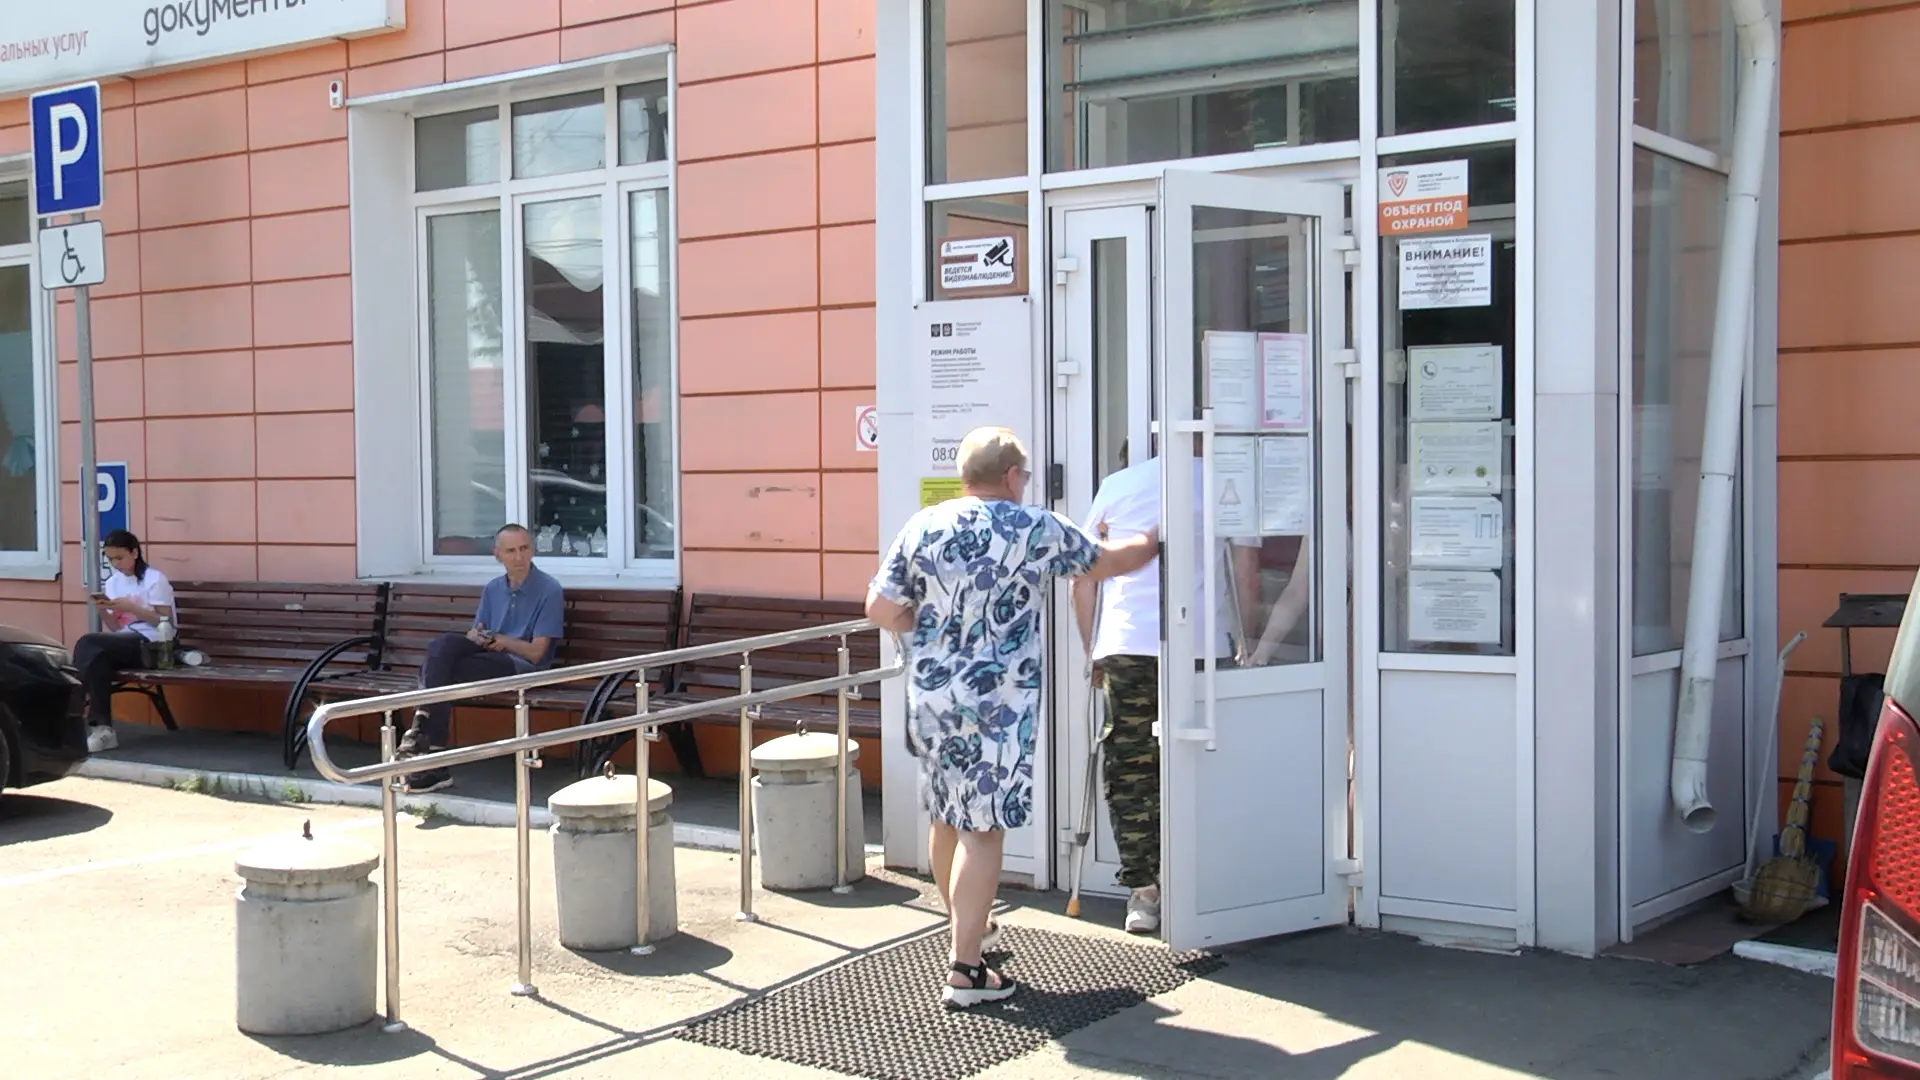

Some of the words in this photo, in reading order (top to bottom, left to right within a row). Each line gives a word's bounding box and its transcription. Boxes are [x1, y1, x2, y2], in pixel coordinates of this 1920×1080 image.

[53, 30, 89, 60] услуг
[50, 102, 88, 201] P
[1382, 202, 1432, 217] ОБЪЕКТ
[1434, 200, 1463, 214] ПОД
[1391, 214, 1454, 230] ОХРАНОЙ
[1405, 246, 1485, 262] ВНИМАНИЕ!
[944, 265, 973, 275] ВЕДЕТСЯ
[930, 348, 952, 356] РЕЖИМ
[953, 347, 977, 355] РАБОТЫ
[932, 447, 960, 461] 08:0
